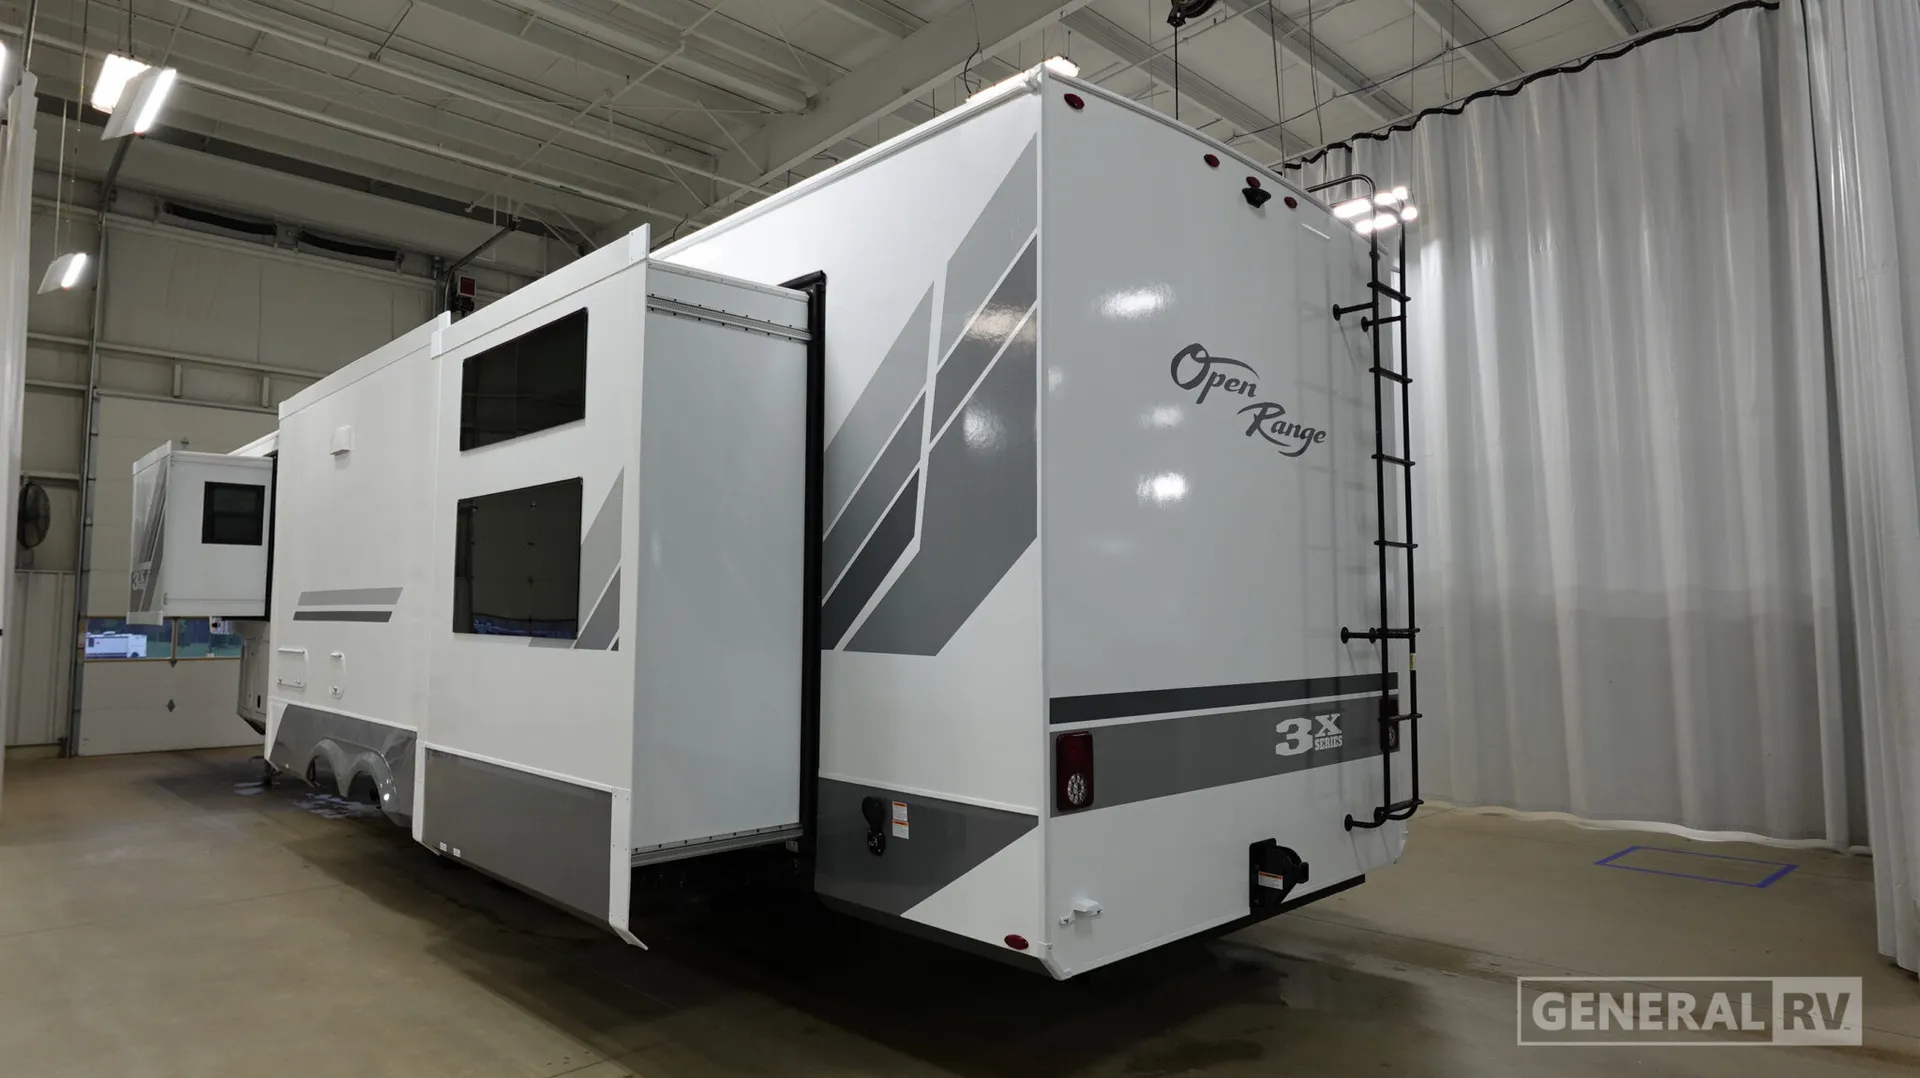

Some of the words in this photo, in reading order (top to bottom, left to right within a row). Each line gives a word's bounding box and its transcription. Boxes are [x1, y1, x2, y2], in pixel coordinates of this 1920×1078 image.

[1171, 343, 1260, 404] Open
[1237, 402, 1326, 457] Range
[1314, 735, 1343, 750] SERIES
